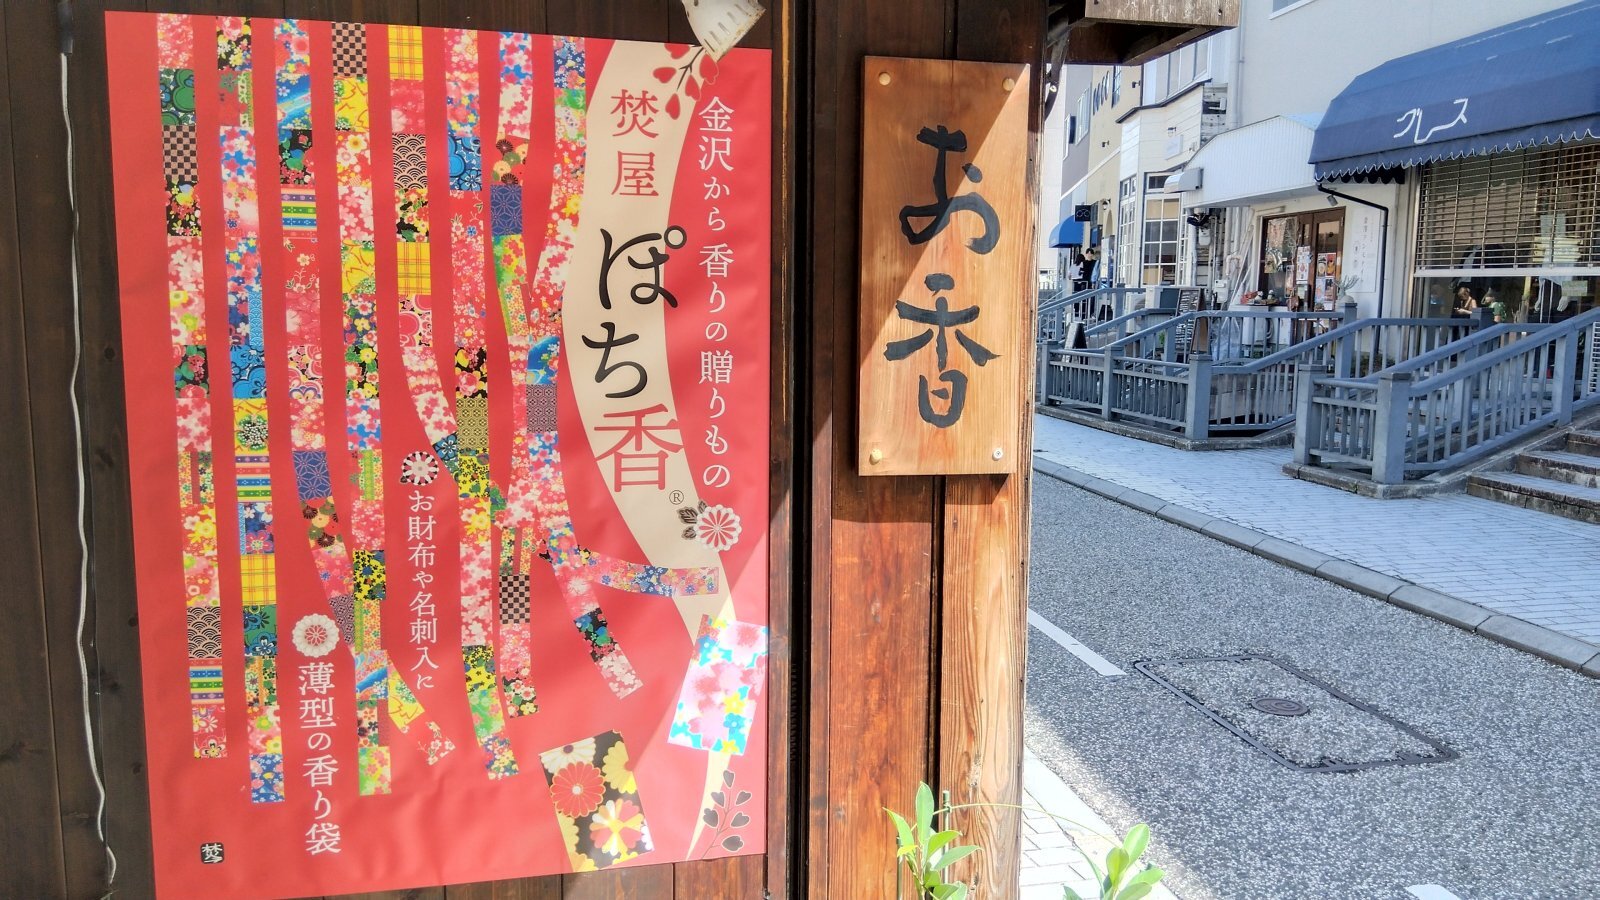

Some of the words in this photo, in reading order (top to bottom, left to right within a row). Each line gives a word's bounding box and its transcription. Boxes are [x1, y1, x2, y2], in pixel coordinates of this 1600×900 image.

[610, 89, 660, 198] 焚屋
[581, 224, 687, 493] ぽち香
[698, 95, 735, 488] 金沢から香りの贈りもの
[883, 124, 1002, 429] お香
[407, 490, 439, 690] お財布や名刺入に
[298, 661, 342, 856] 薄型の香り袋
